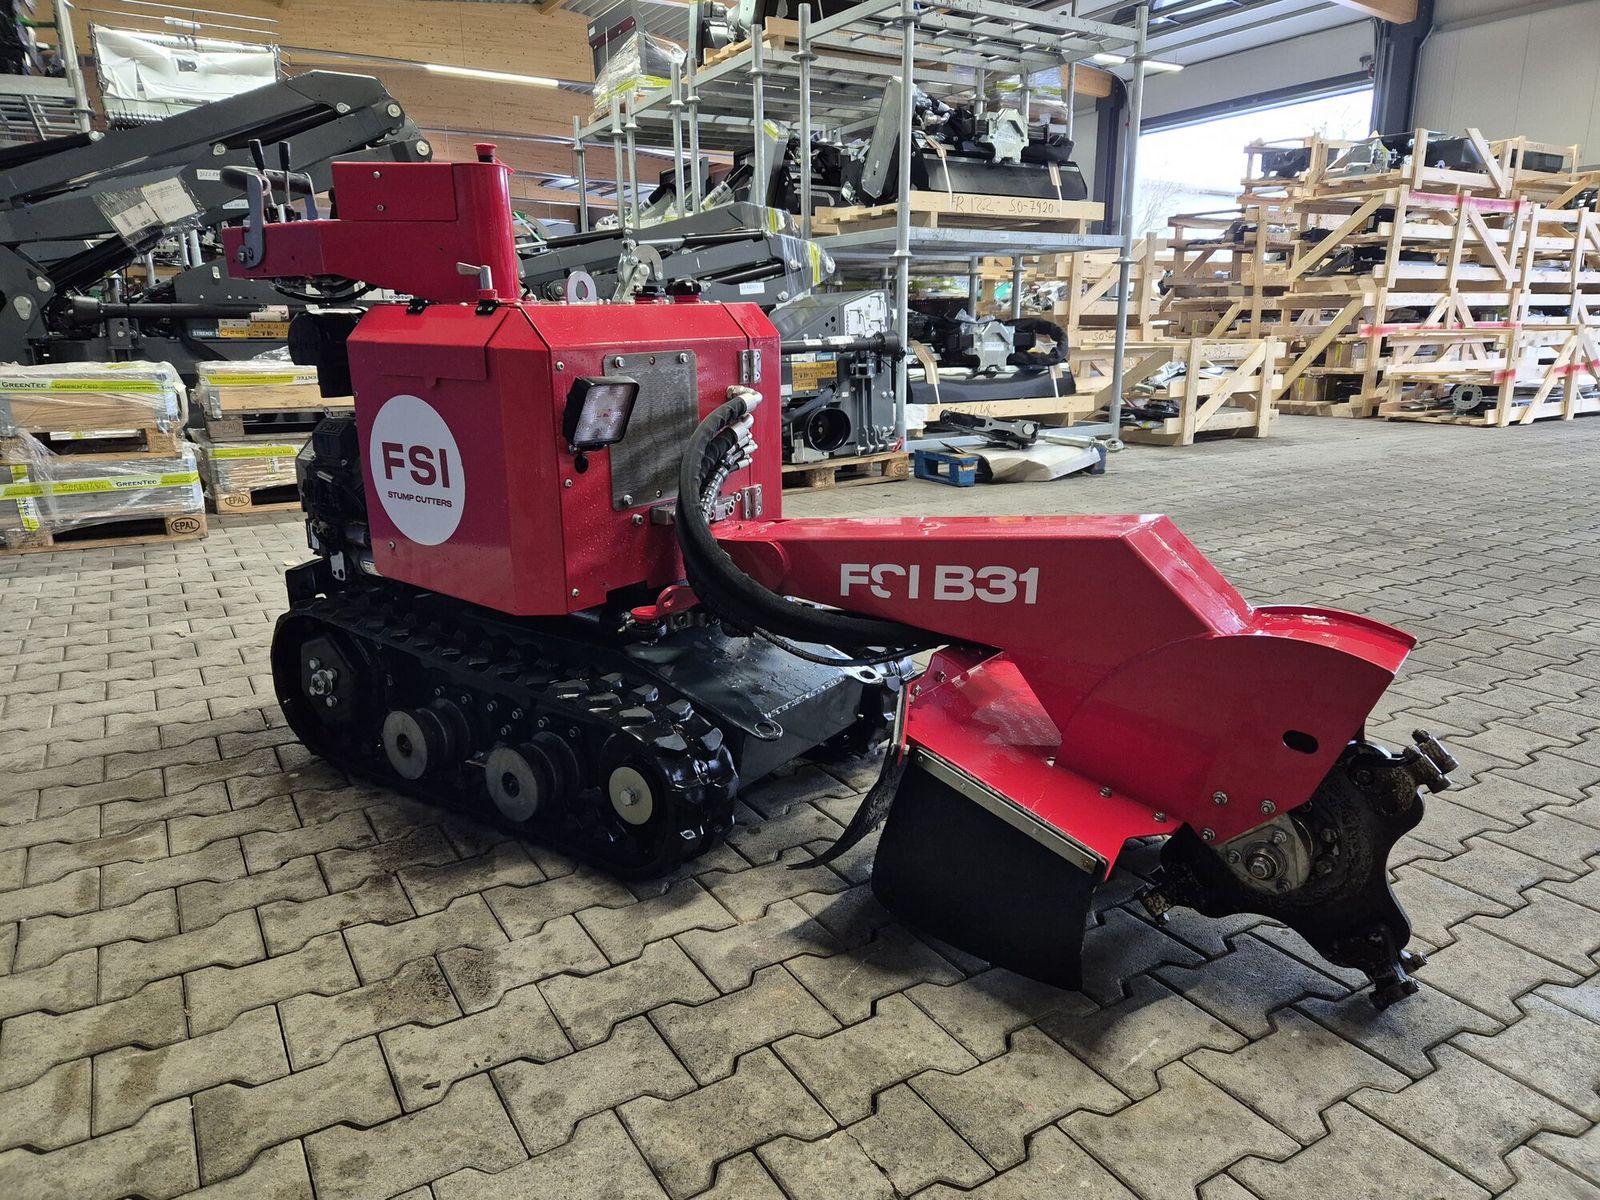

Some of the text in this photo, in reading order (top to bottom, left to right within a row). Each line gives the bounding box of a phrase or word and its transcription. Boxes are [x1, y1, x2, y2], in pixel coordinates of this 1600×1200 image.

[382, 442, 450, 488] FSI
[228, 496, 247, 505] EPAL
[387, 491, 452, 508] STUMP CUTTERS
[174, 520, 197, 531] EPAL
[840, 563, 1039, 604] FSI B31
